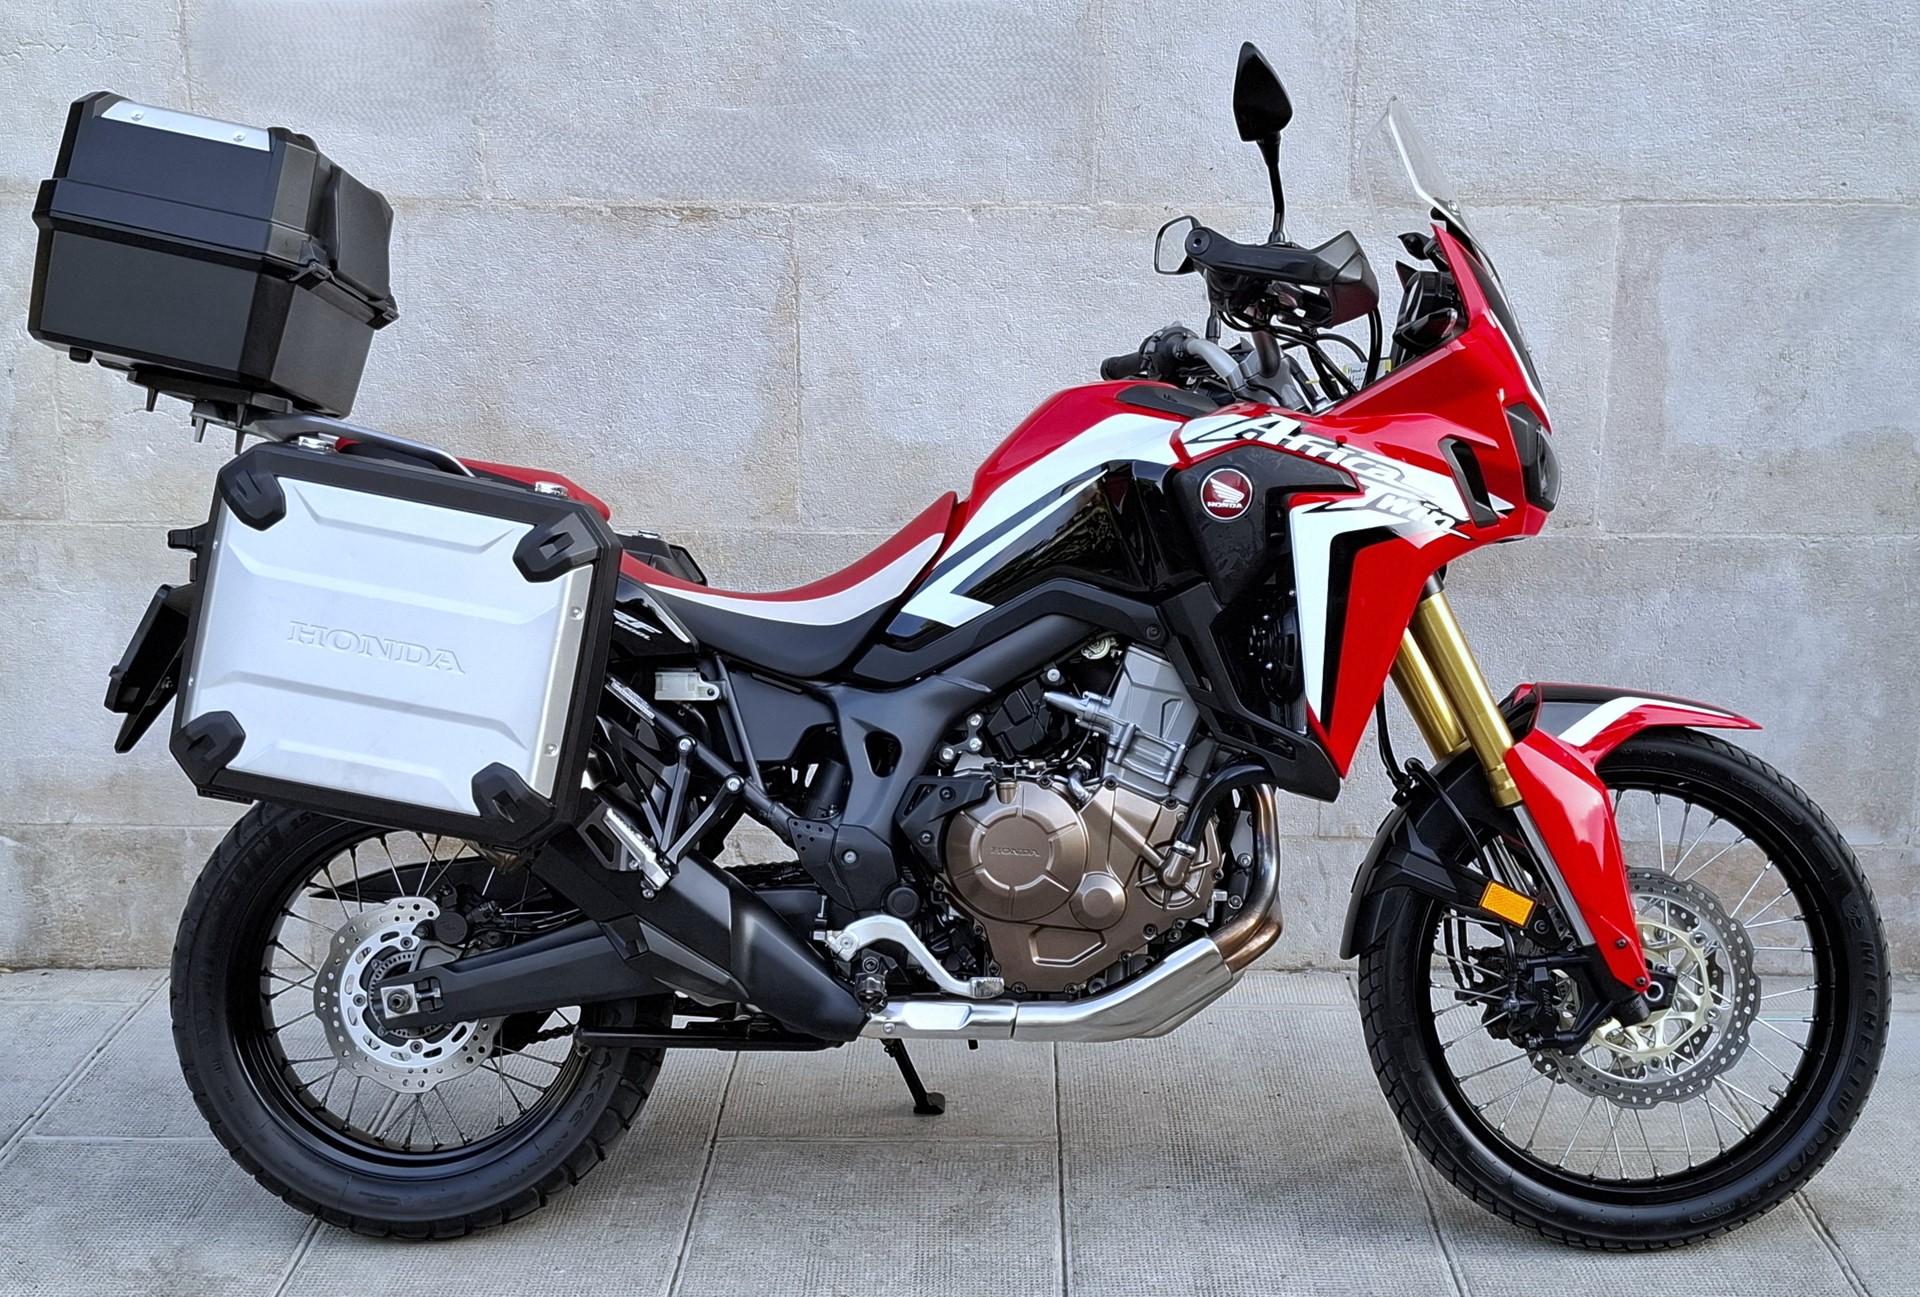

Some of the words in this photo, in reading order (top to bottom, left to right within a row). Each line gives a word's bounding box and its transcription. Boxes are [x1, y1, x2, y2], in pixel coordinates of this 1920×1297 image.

[1207, 501, 1244, 510] HONDA
[287, 620, 466, 675] HONDA
[990, 846, 1041, 858] HONDA
[1836, 940, 1880, 1113] MICHELIN
